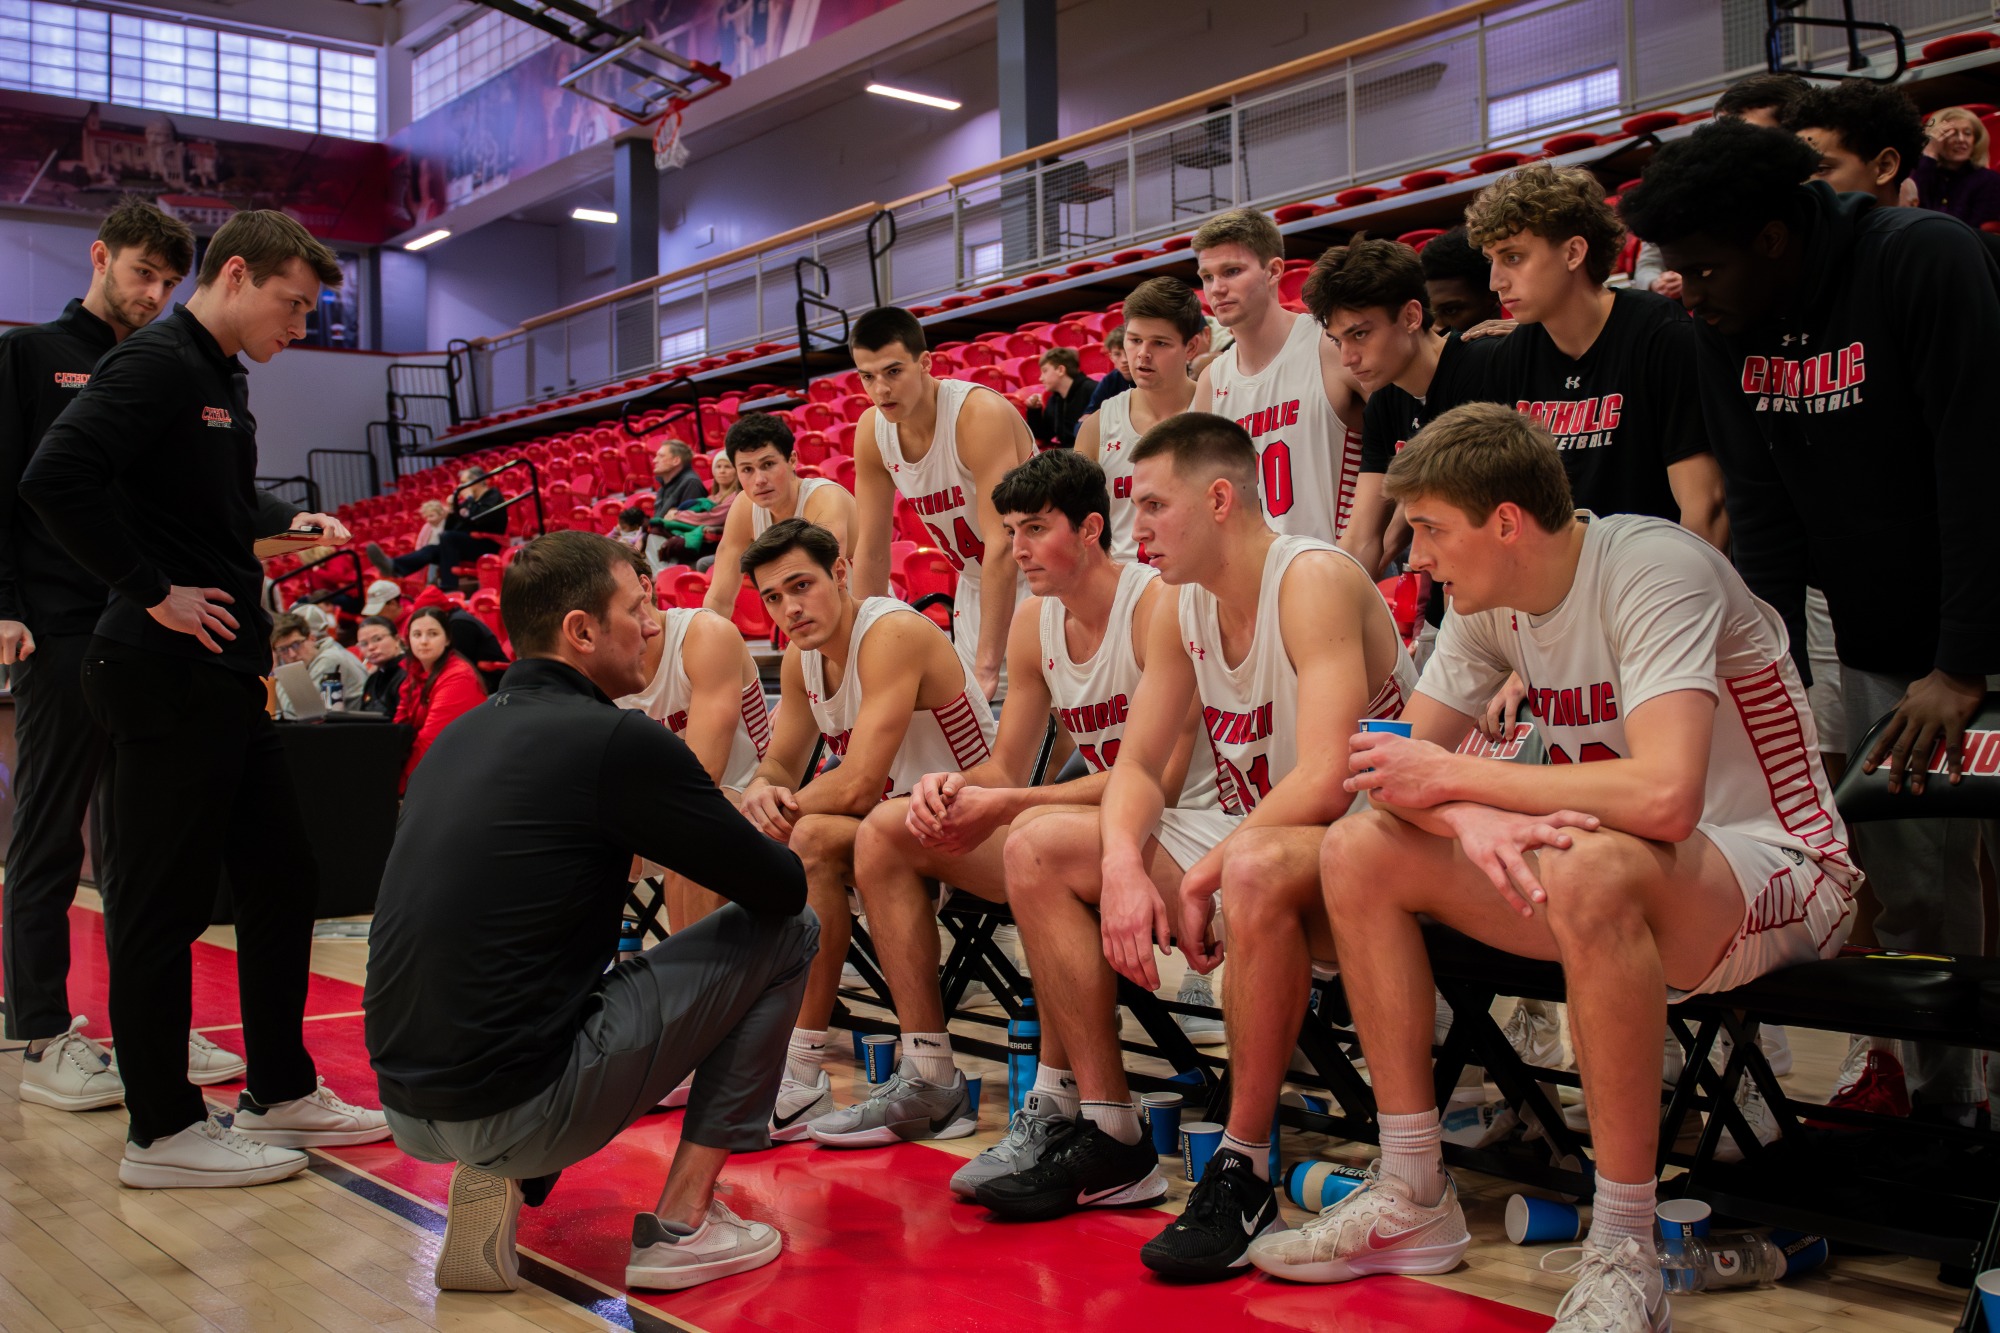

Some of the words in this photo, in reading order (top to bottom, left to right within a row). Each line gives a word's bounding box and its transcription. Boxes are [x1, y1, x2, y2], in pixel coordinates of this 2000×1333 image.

[1756, 387, 1863, 414] BASTBALL
[868, 1044, 877, 1082] POWERADE
[1183, 1133, 1193, 1180] POWERADE
